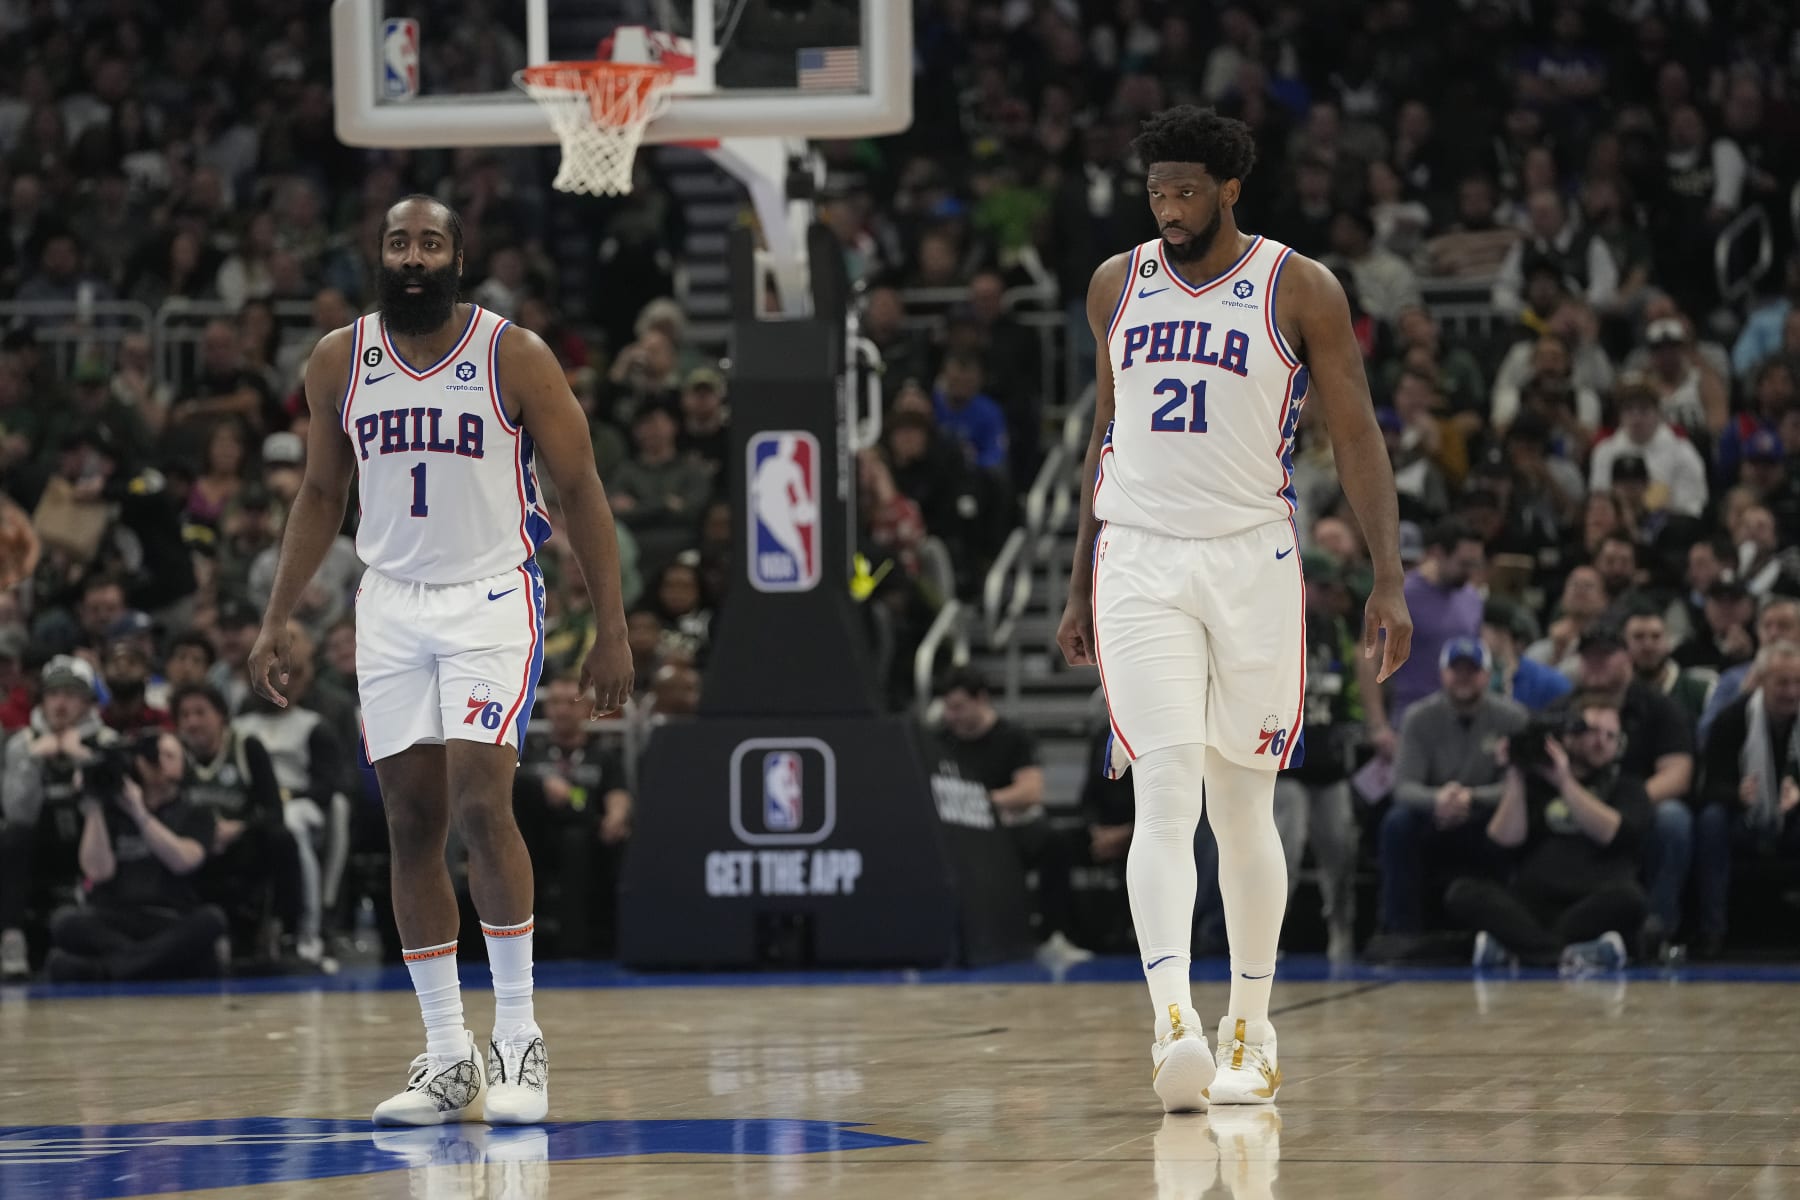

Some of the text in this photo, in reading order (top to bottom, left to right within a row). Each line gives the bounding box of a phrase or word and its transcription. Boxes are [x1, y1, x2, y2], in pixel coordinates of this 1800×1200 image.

[1143, 262, 1156, 276] 6
[1221, 300, 1259, 310] crypto.com
[367, 350, 379, 365] 6
[1121, 320, 1250, 377] PHILA
[445, 384, 484, 392] crypto.com
[1151, 378, 1208, 433] 21
[355, 407, 485, 461] PHILA
[411, 462, 428, 518] 1
[463, 696, 503, 730] 76
[1254, 728, 1287, 756] 76
[705, 850, 863, 896] GET THE APP
